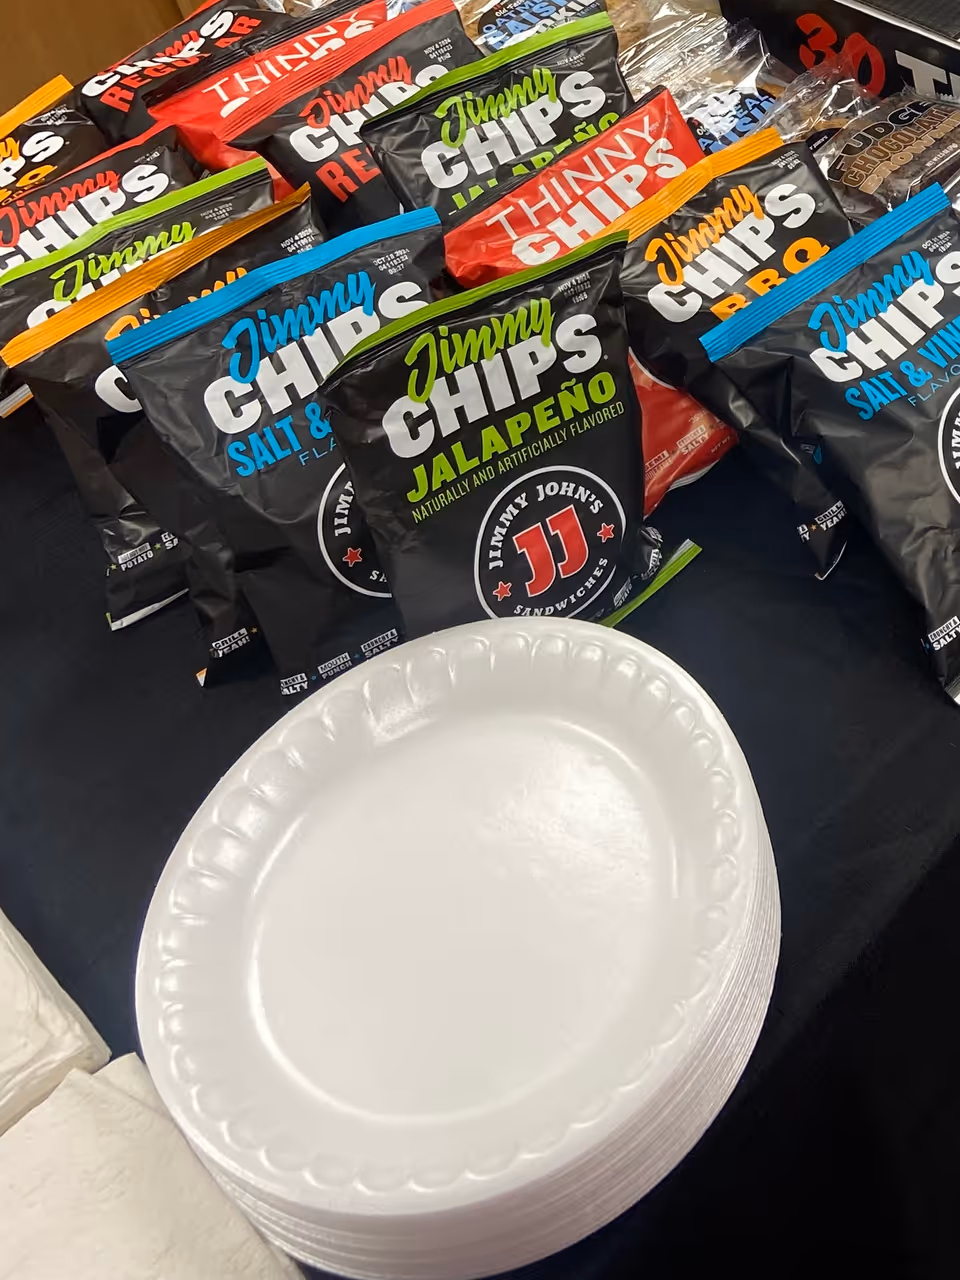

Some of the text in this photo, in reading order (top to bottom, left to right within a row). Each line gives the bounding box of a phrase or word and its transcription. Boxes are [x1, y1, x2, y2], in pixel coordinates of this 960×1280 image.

[202, 11, 358, 102] THINNY
[299, 56, 412, 129] Jimmy
[795, 12, 886, 98] 30
[421, 71, 607, 190] CHIPS
[434, 68, 557, 148] Jimmy
[827, 100, 937, 182] FUDGE
[842, 104, 956, 187] CHOCOLATE
[0, 170, 120, 248] Jimmy
[485, 116, 655, 242] THINNY
[512, 137, 688, 266] CHIPS
[50, 221, 197, 301] Jimmy
[645, 184, 765, 286] Jimmy
[647, 183, 816, 322] CHIPS
[709, 236, 830, 321] BBQ
[807, 251, 935, 353] Jimmy
[204, 281, 429, 435] CHIPS
[221, 271, 376, 384] Jimmy
[404, 298, 556, 403] Jimmy
[382, 313, 602, 458] CHIPS
[845, 371, 908, 421] SALT
[900, 360, 933, 388] &
[227, 415, 301, 477] SALT
[304, 402, 332, 440] &
[406, 371, 617, 503] JALAPEÑO
[411, 400, 626, 524] NATURALLY AND ARTIFICIALLY FLAVORED
[120, 550, 154, 571] POTATO
[488, 479, 604, 571] JIMMY JOHN'S
[512, 504, 589, 598] JJ
[513, 555, 609, 617] SANDWICHES
[213, 628, 247, 648] GRILL
[218, 636, 250, 658] YEAH!
[318, 651, 349, 674] MOUTH
[321, 660, 353, 681] PUNCH
[929, 618, 953, 643] CRUNCHY
